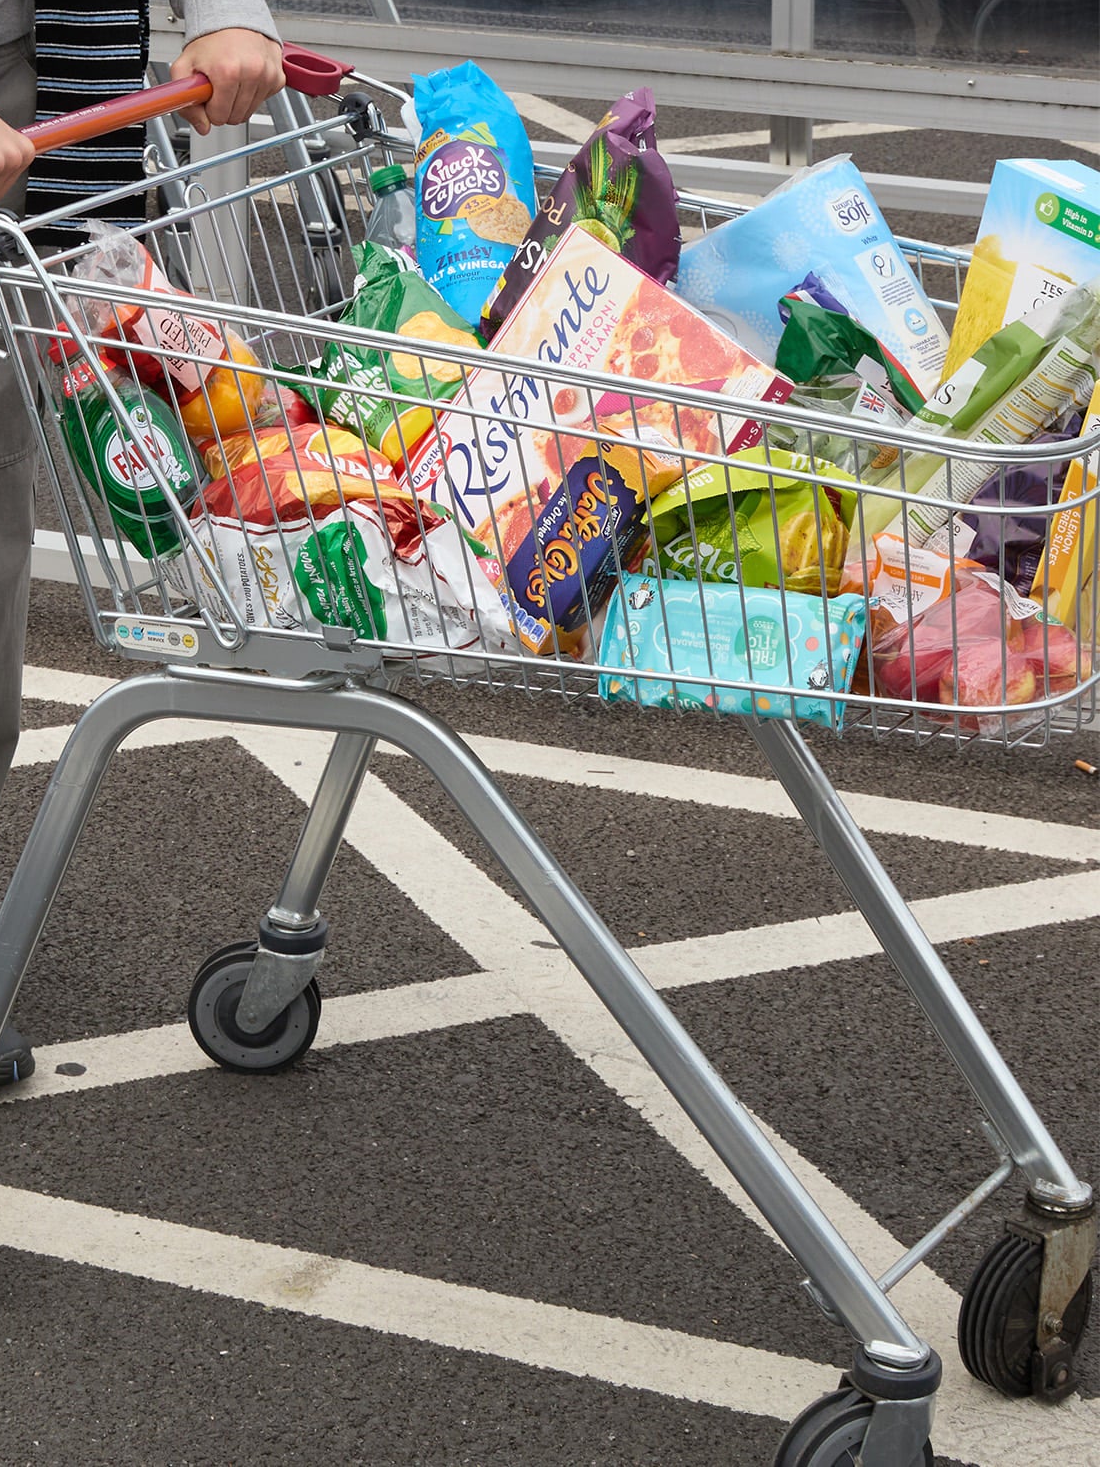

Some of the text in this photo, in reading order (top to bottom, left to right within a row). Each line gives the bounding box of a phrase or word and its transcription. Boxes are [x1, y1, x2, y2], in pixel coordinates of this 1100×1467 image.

[425, 146, 492, 201] Snack
[430, 167, 500, 215] Jacks
[1062, 217, 1087, 236] Vitamin
[1064, 207, 1080, 221] High
[436, 245, 492, 272] Zingy
[426, 260, 510, 284] ALT & VINEGA
[1043, 279, 1067, 297] TES
[564, 299, 616, 369] EPPERONI
[330, 365, 383, 424] VINGAR
[1062, 518, 1079, 555] LEMON
[891, 583, 925, 603] APLES
[661, 637, 730, 651] BIODGRADABE
